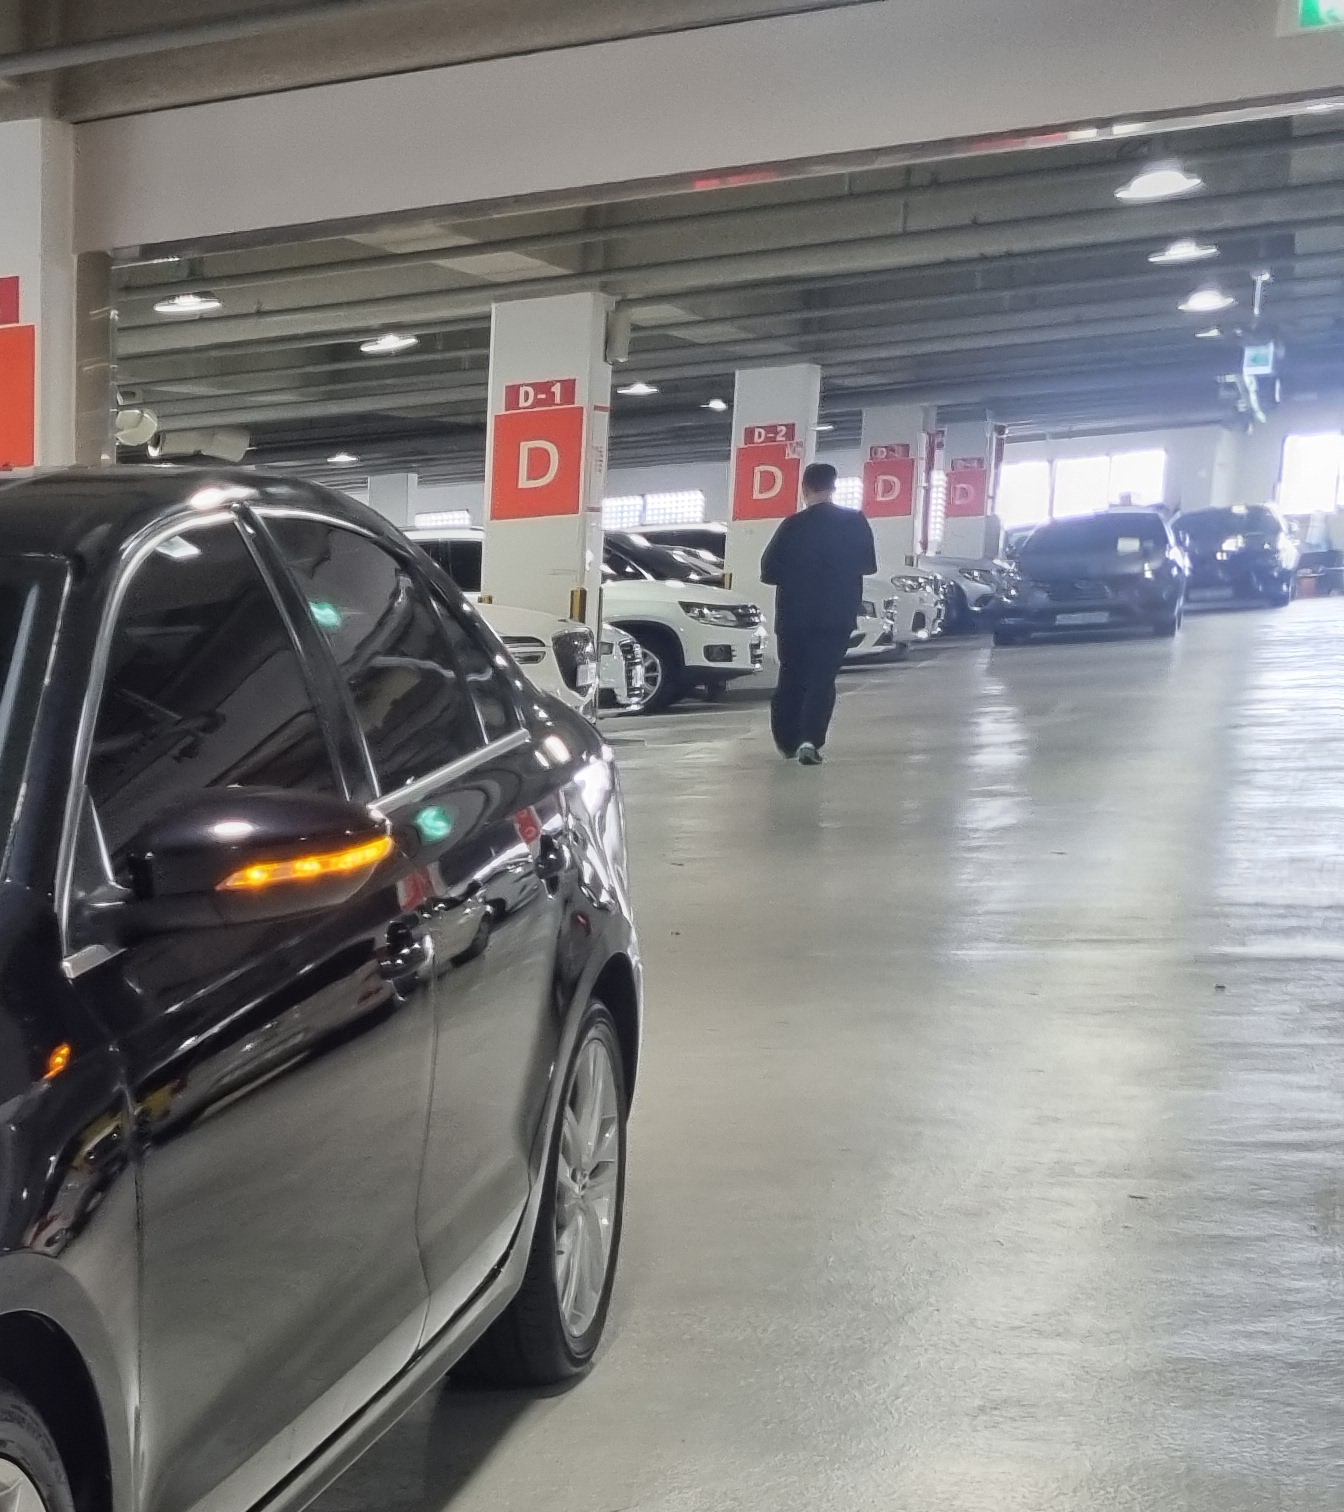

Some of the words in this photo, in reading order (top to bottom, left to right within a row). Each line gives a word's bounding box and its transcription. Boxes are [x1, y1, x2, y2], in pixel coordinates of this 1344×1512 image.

[519, 382, 561, 408] D-1
[754, 425, 787, 443] D-2
[518, 440, 559, 489] D
[753, 465, 783, 499] D
[875, 475, 901, 501] D
[954, 483, 975, 505] D
